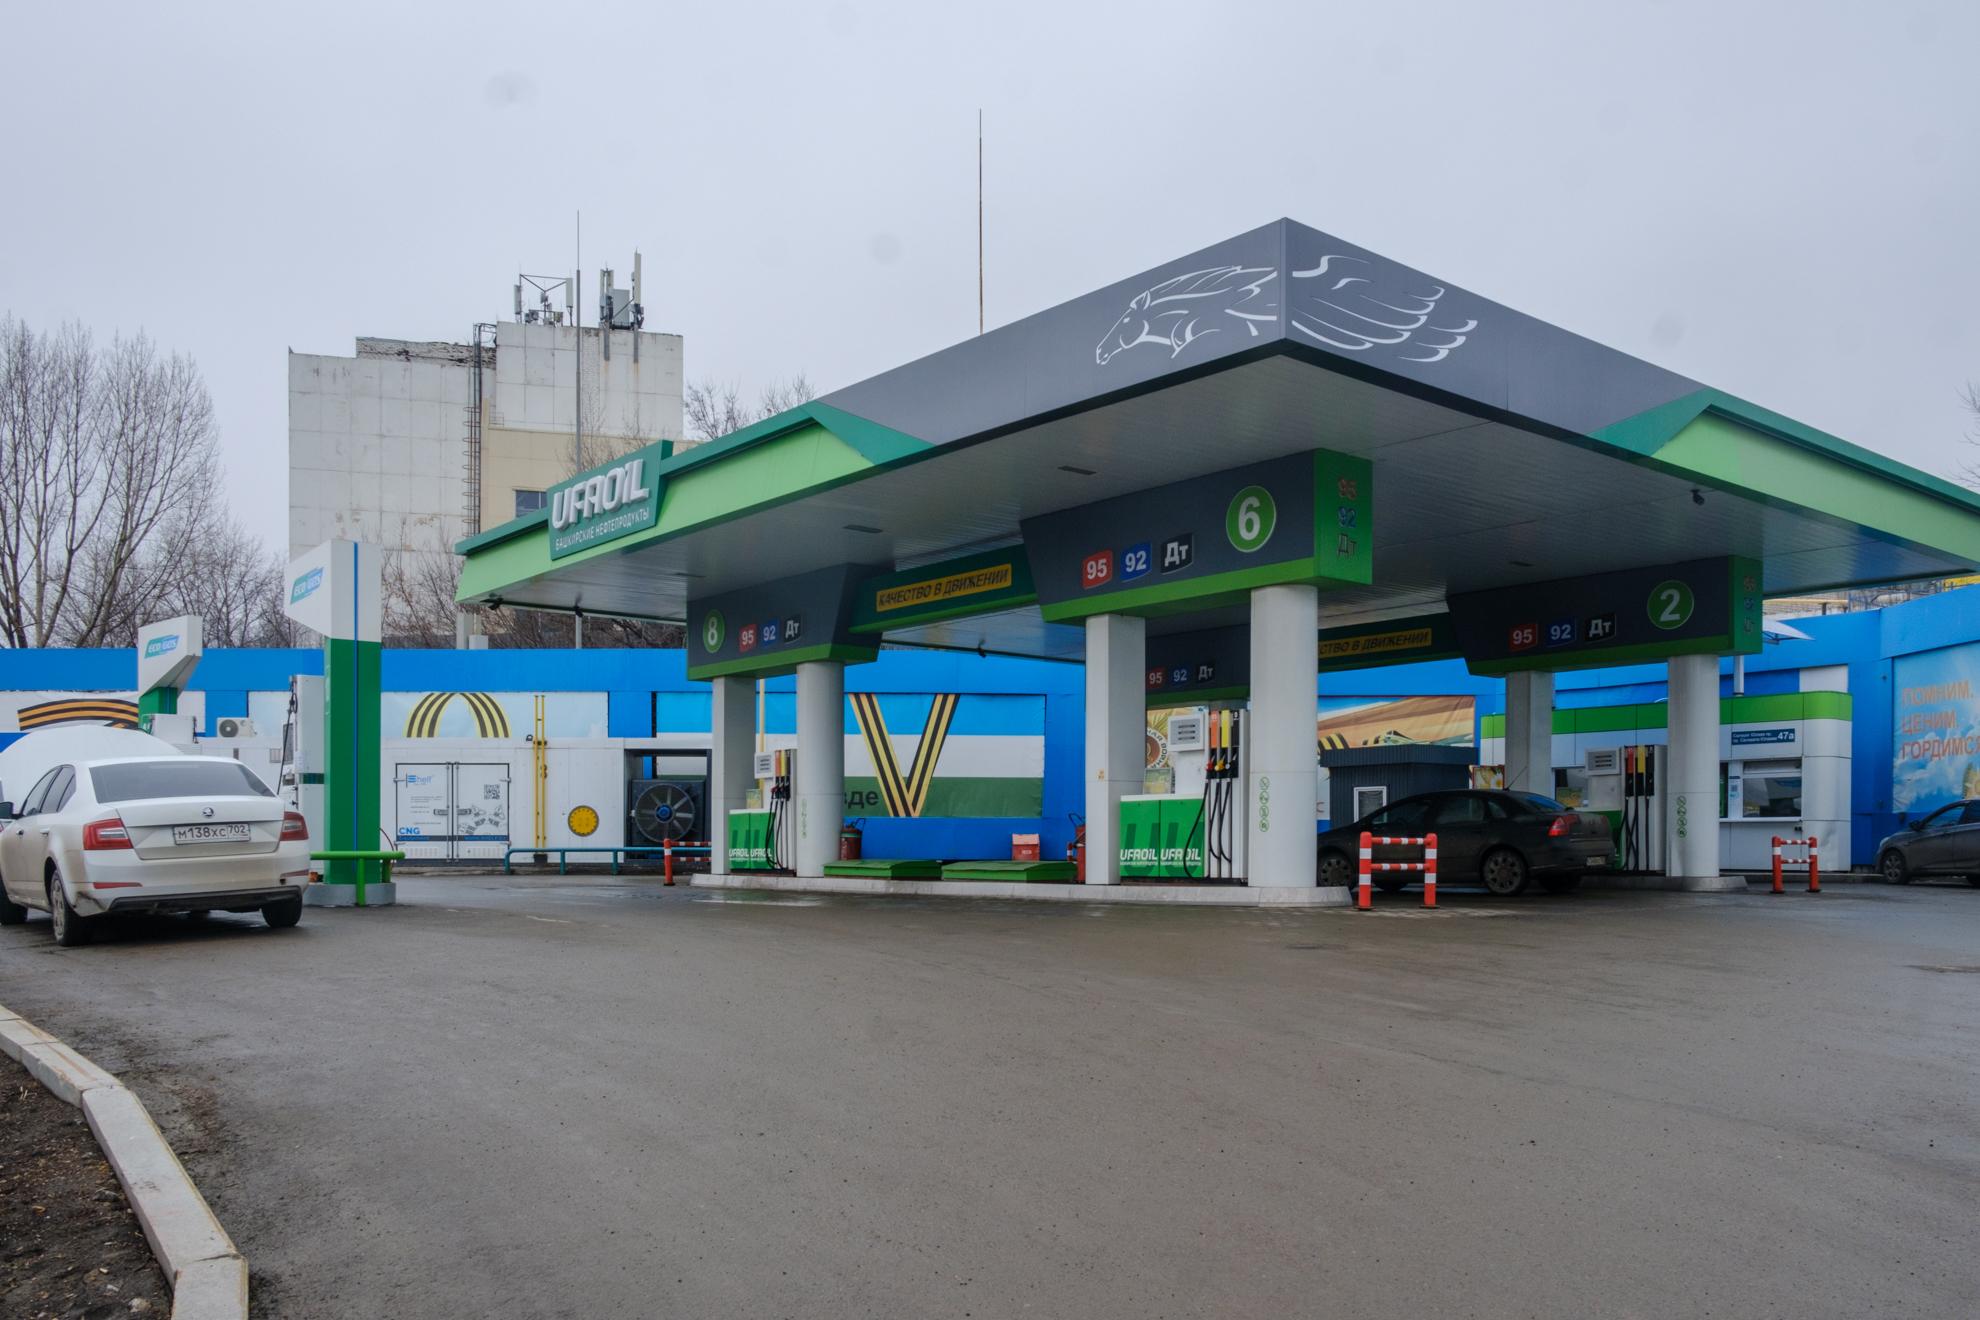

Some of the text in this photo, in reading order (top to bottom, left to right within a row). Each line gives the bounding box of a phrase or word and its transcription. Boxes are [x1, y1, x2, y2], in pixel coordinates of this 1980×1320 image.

[552, 459, 650, 530] UFAOIL
[555, 507, 650, 551] БАШКИРСКИЕ НЕФТЕПРОДУКТЫ
[1238, 496, 1261, 541] 6
[1086, 541, 1189, 580] 95 92 Дт
[878, 568, 1009, 606] КАЧЕСТВО В ДВИЖЕНИИ
[1659, 588, 1681, 622] 2
[708, 616, 720, 646] 8
[742, 619, 800, 646] 95 92 Дт
[1512, 618, 1612, 645] 95 92 Дт
[1317, 641, 1350, 656] СТВО
[1148, 666, 1214, 684] 95 92 Дт
[844, 790, 880, 810] де
[228, 824, 246, 834] 702
[398, 827, 421, 836] CNG
[1120, 848, 1158, 861] UFAOIL
